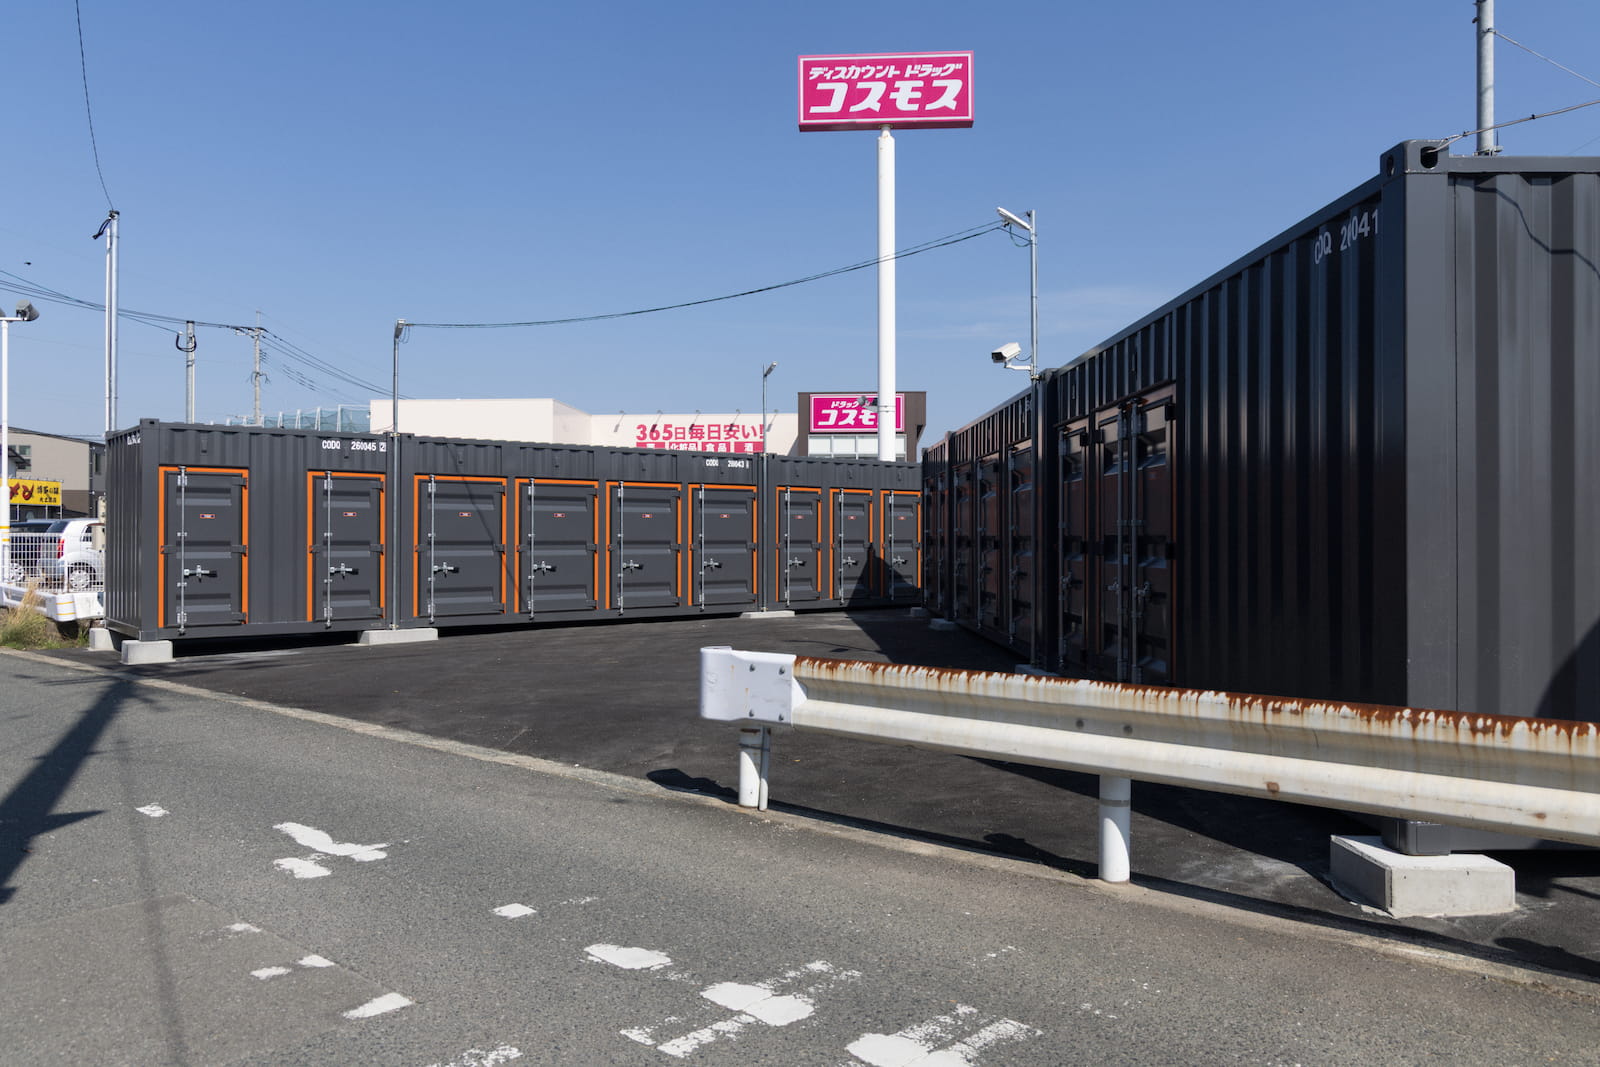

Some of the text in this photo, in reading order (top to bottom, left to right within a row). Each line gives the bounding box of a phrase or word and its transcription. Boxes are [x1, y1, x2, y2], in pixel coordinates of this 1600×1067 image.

[809, 63, 962, 80] ディスカウント ドラッグ
[809, 79, 963, 113] コスモス
[818, 409, 878, 425] コスモ
